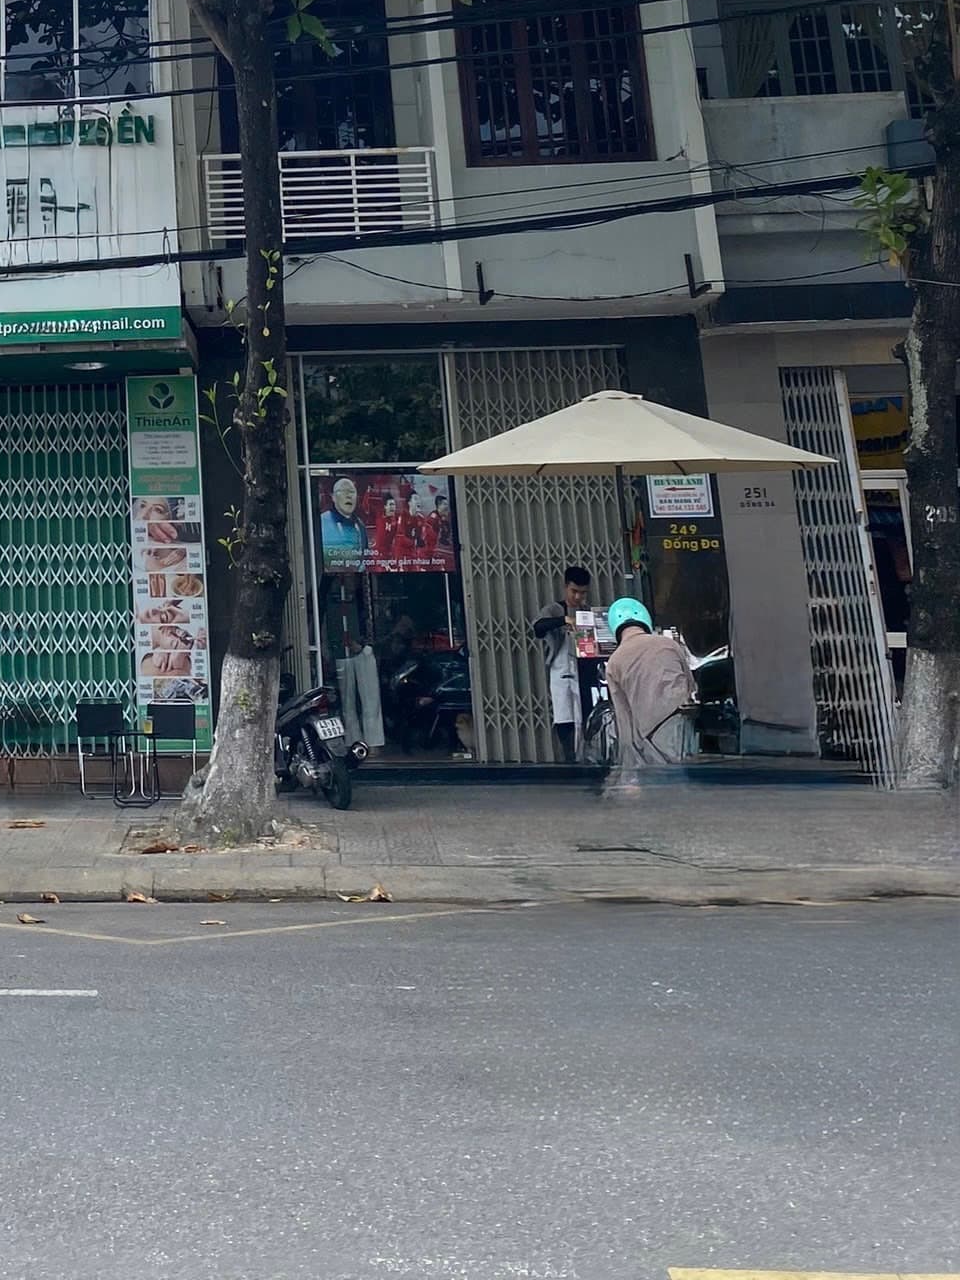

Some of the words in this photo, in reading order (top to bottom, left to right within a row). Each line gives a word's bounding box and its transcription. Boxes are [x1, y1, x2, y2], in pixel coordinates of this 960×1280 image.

[744, 487, 768, 499] 251
[669, 523, 697, 535] 249
[662, 535, 699, 551] Đống
[700, 538, 720, 550] Đa
